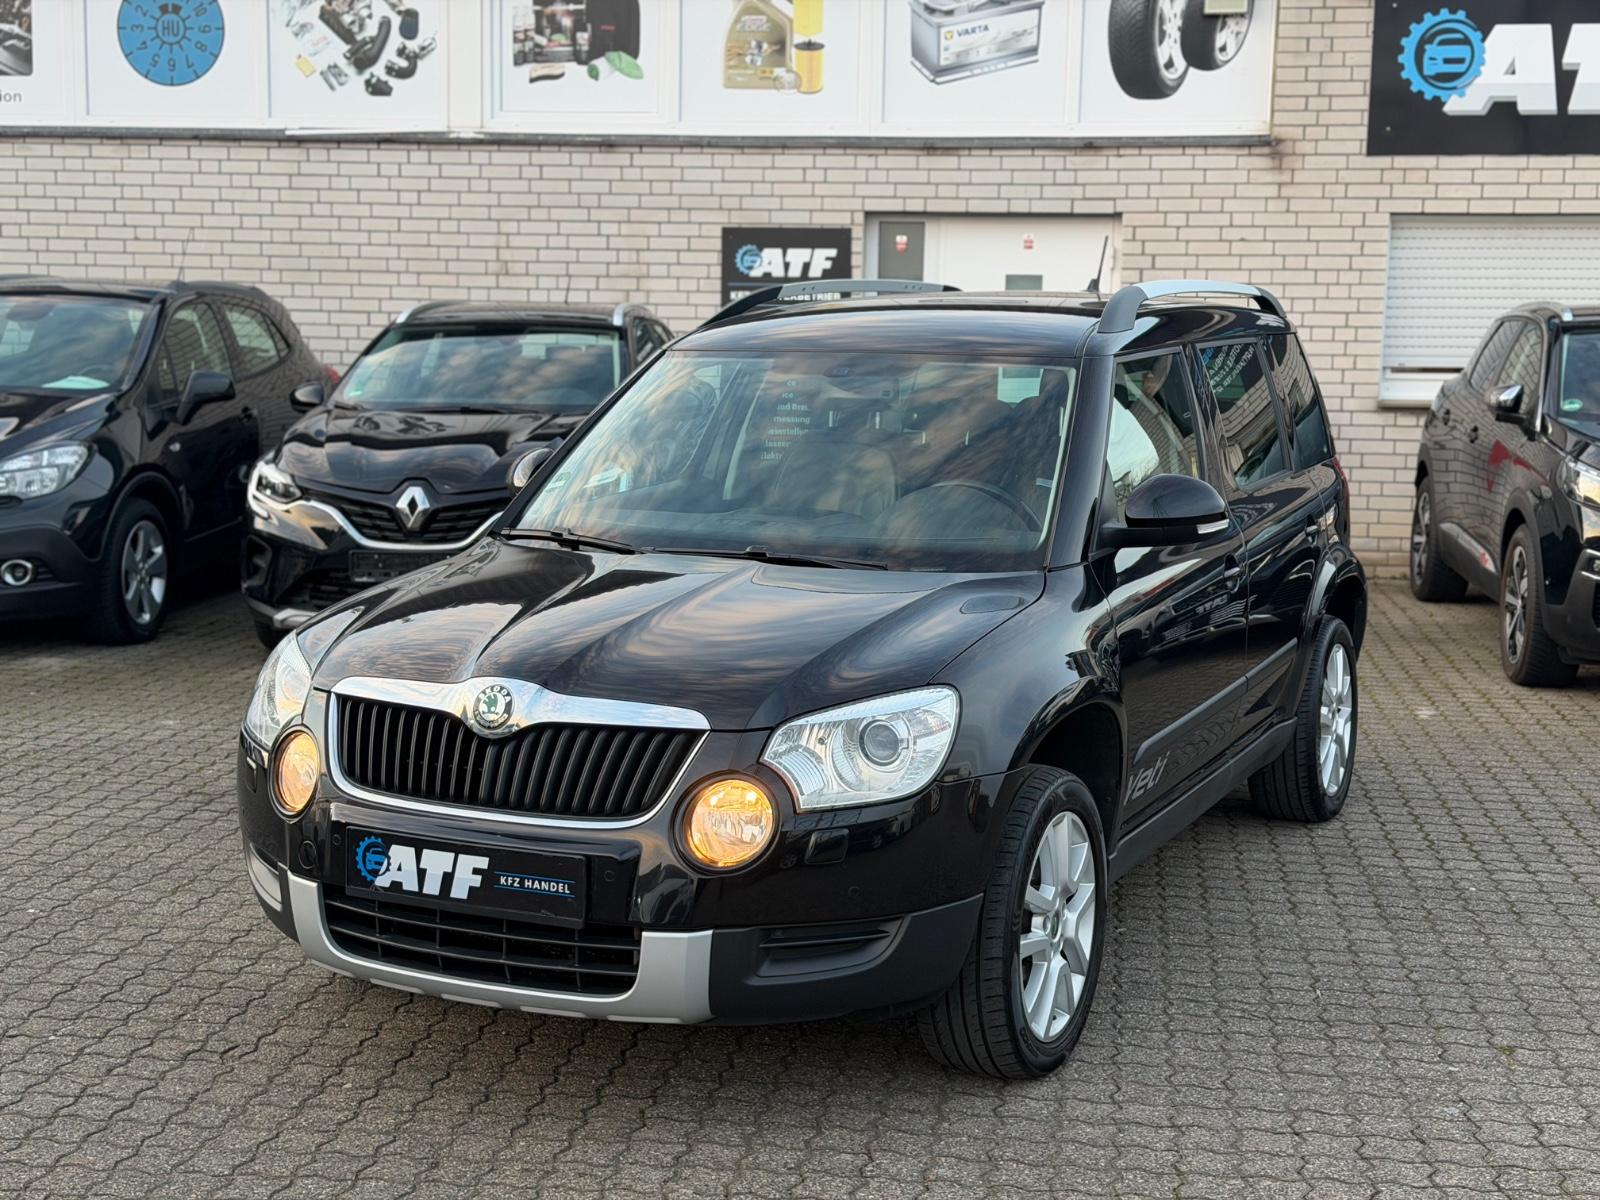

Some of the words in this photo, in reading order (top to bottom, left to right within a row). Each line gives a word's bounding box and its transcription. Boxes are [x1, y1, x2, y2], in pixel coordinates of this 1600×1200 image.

[134, 4, 149, 17] 2
[130, 23, 145, 33] 3
[161, 20, 180, 37] HU
[956, 24, 990, 37] VARTA
[194, 40, 208, 53] 8
[748, 247, 838, 278] ATF
[374, 844, 490, 900] ATF
[499, 875, 521, 889] KFZ
[524, 878, 571, 894] HANDEL
